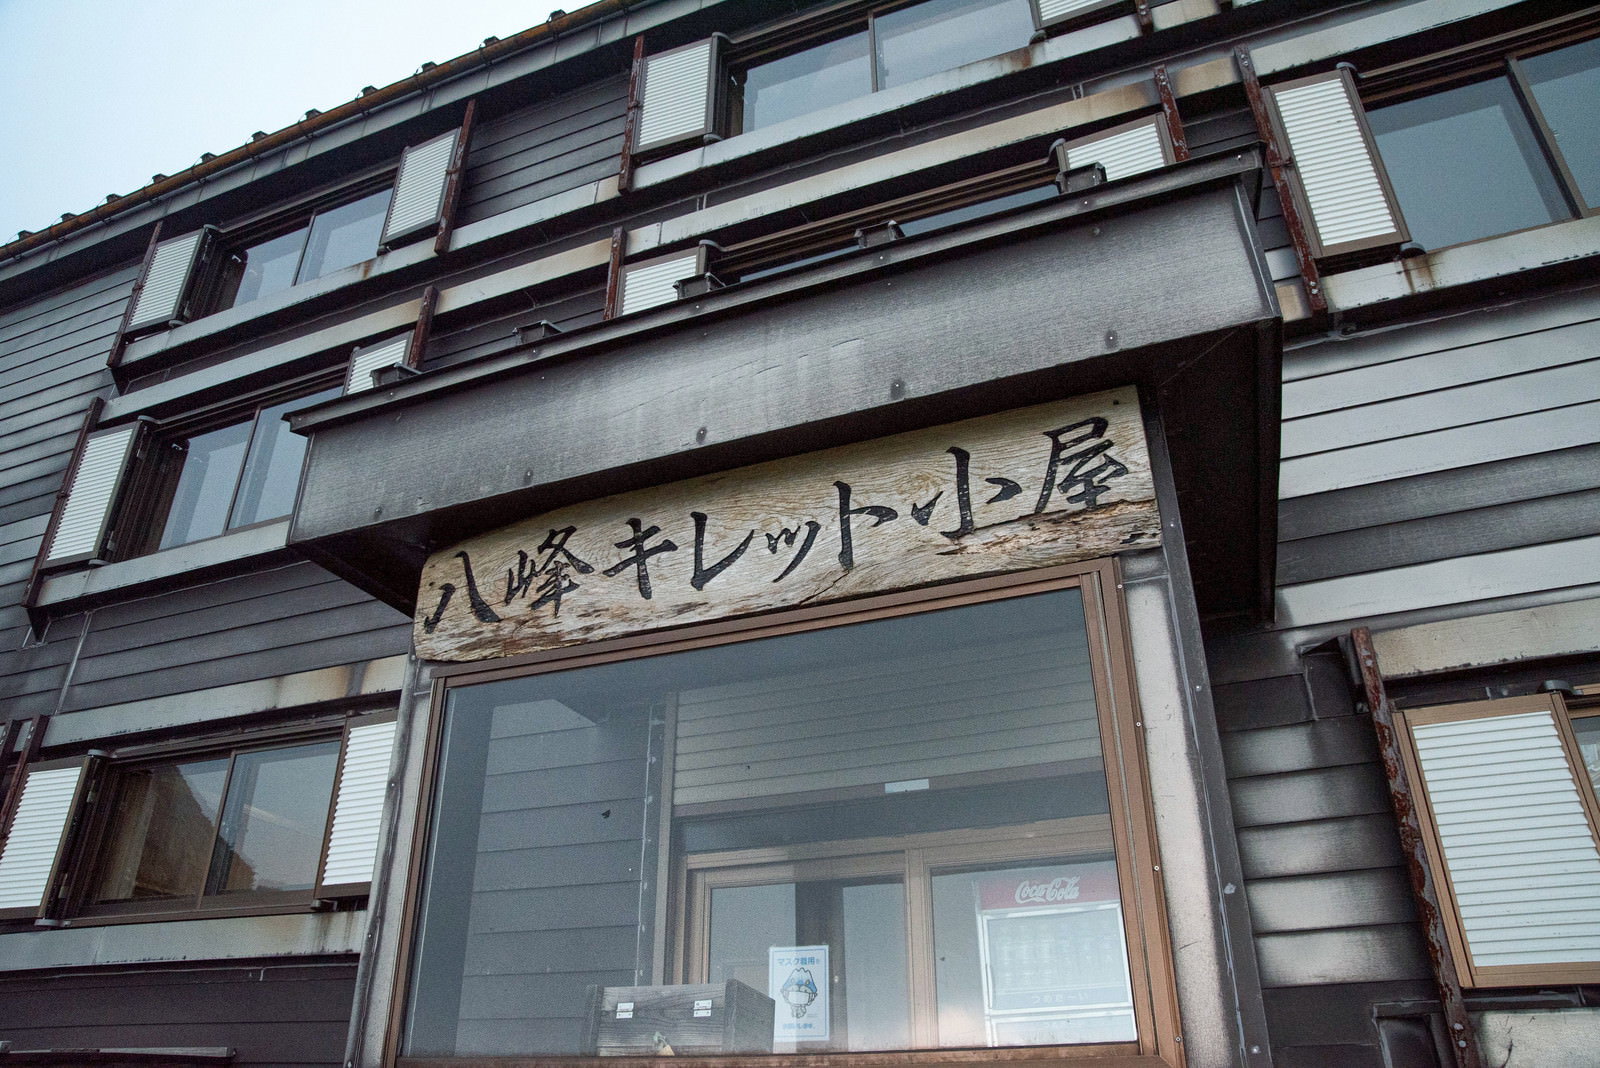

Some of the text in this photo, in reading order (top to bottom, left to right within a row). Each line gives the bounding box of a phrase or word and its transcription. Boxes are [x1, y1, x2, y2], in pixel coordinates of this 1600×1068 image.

[424, 416, 1129, 634] 八峰キレット小屋
[1015, 876, 1080, 904] Coca-Cola
